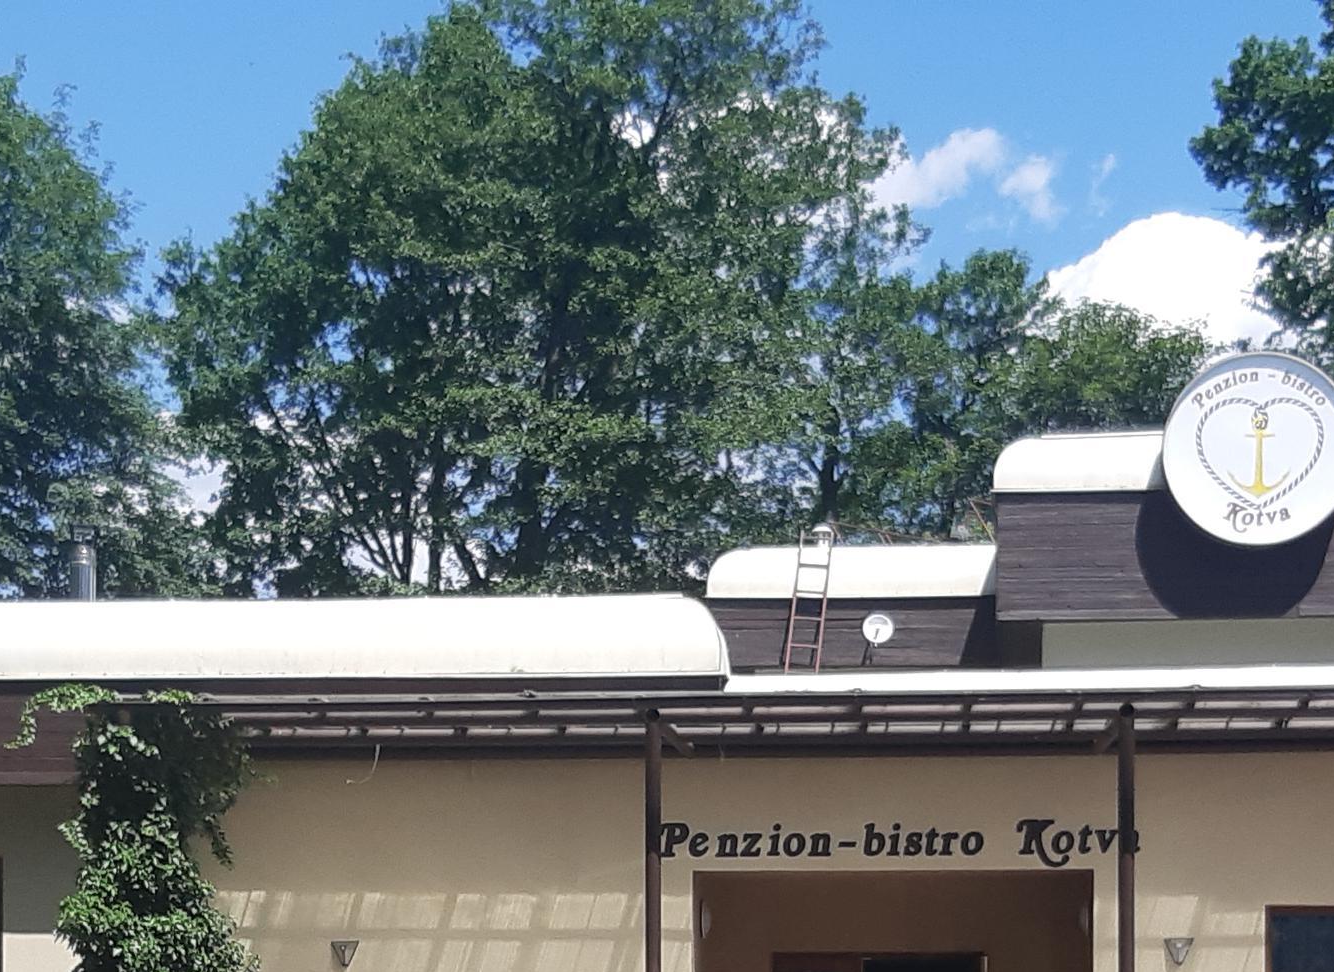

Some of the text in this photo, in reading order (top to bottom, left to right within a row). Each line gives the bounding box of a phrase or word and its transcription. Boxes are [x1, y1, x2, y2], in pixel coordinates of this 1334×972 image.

[1191, 371, 1260, 410] Penzion
[1280, 370, 1327, 408] bistro
[1223, 501, 1291, 534] Kotva
